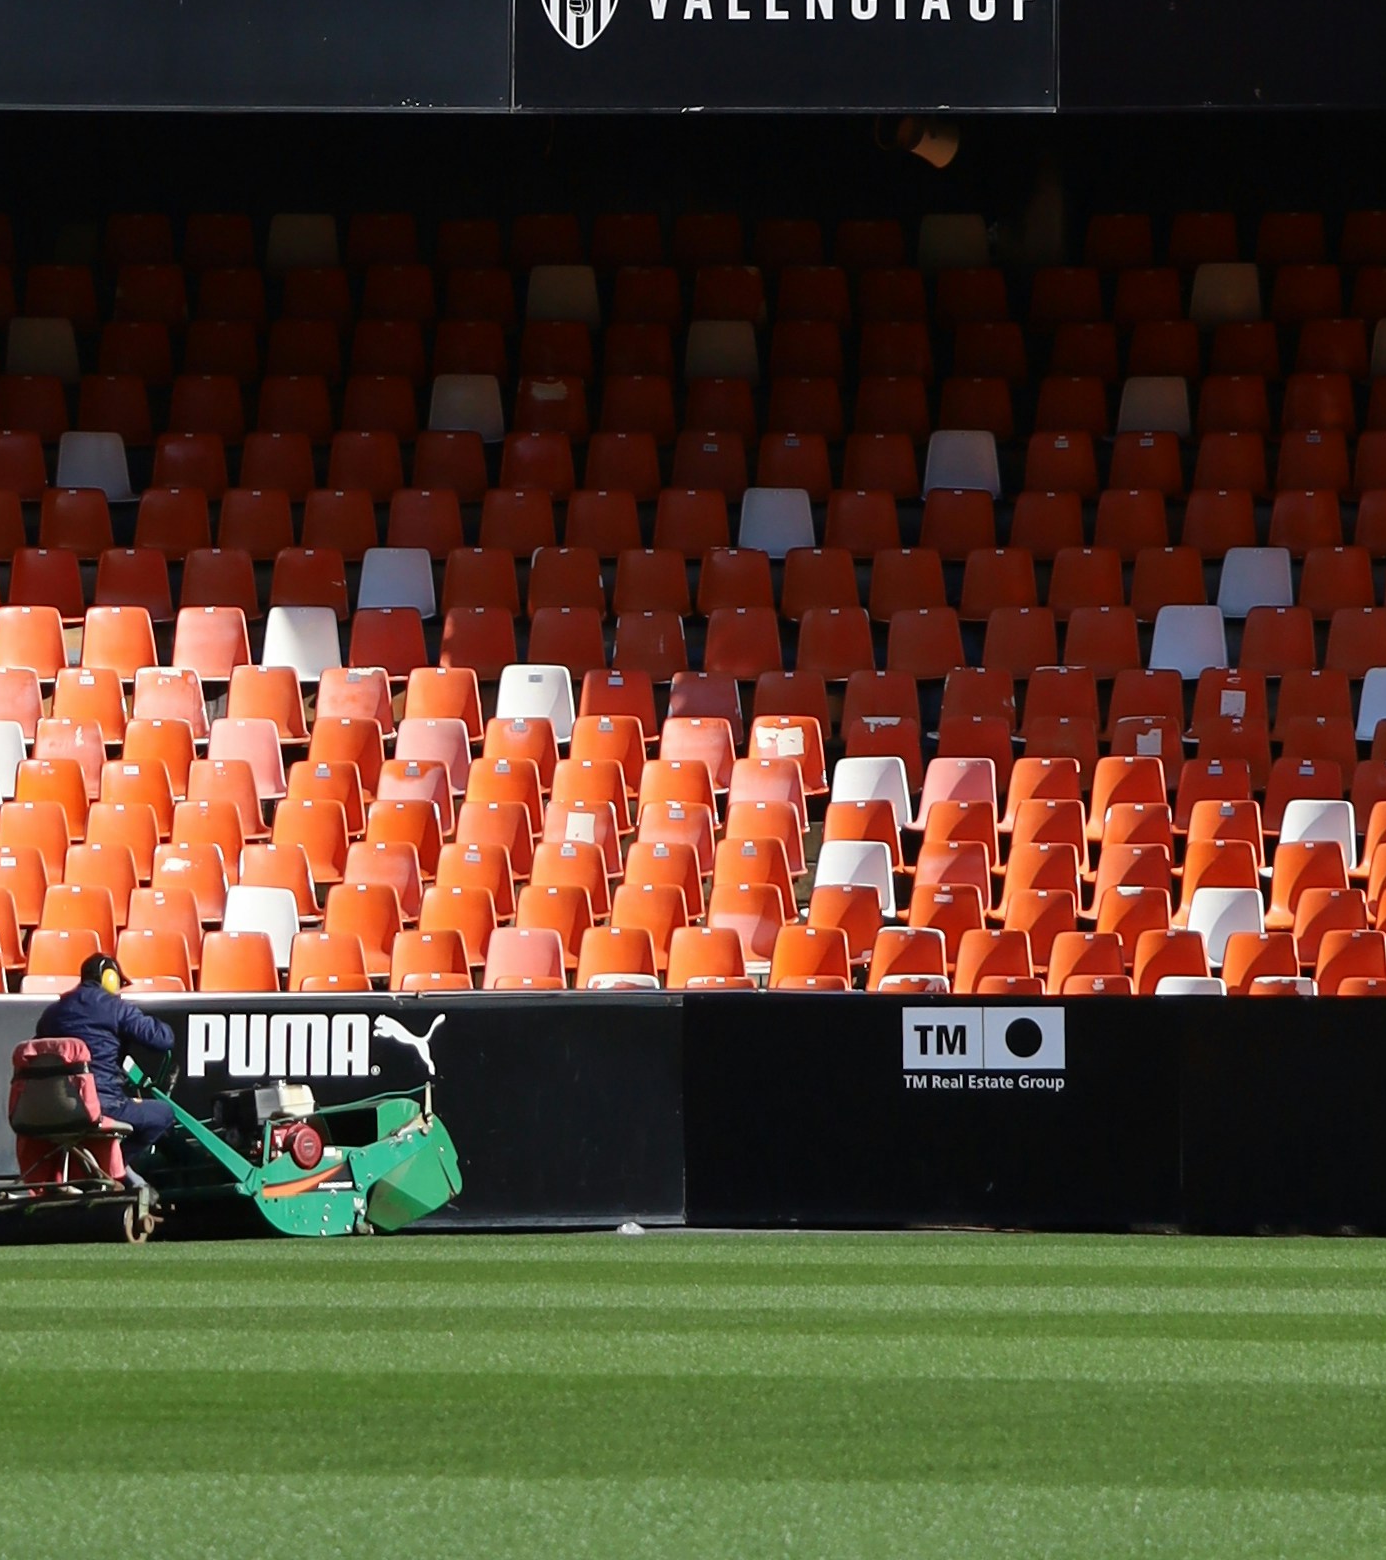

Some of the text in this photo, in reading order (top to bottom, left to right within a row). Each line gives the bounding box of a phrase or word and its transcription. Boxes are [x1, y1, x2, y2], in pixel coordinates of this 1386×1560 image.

[187, 1013, 371, 1077] PUMA
[913, 1024, 968, 1056] TM
[903, 1074, 1065, 1093] TM Real Estate Group
